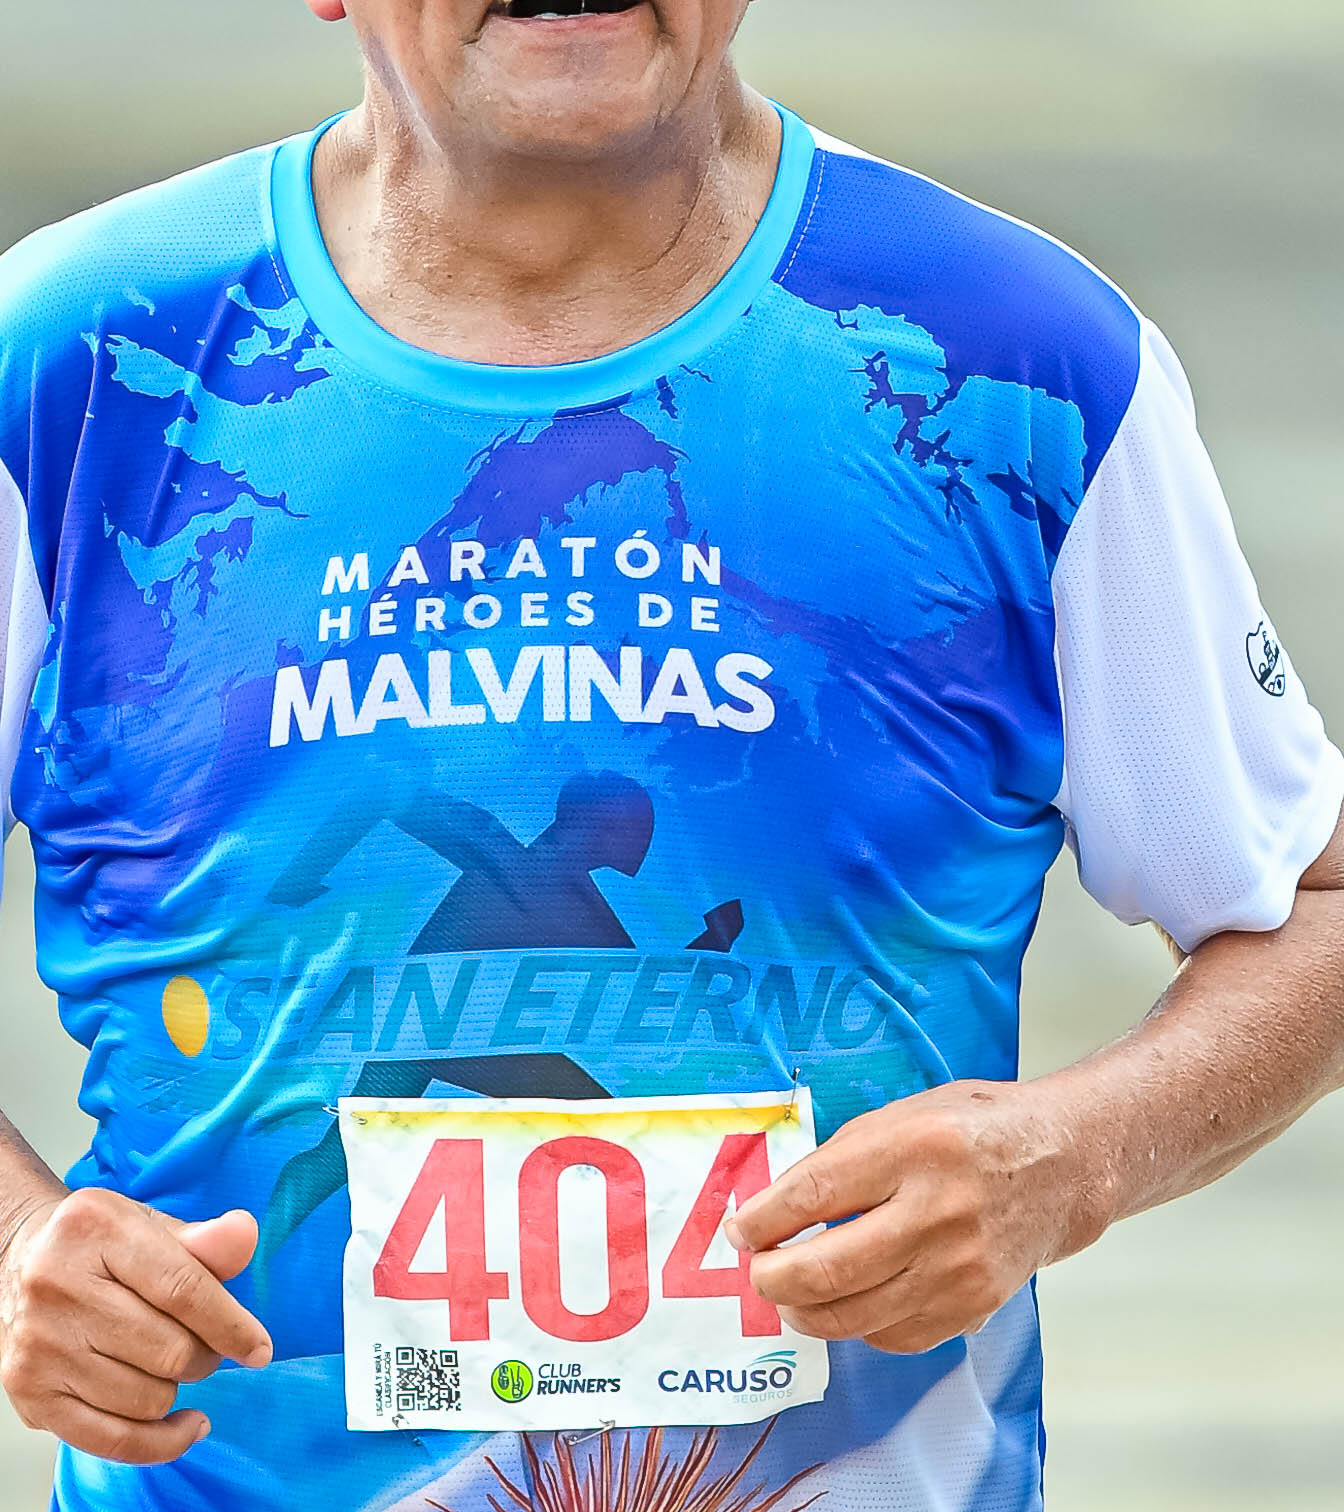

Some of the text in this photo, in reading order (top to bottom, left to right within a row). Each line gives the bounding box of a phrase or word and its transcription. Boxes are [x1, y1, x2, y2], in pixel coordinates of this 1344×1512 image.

[321, 528, 721, 596] MARATÓN
[317, 590, 721, 643] HÉROES DE
[268, 644, 776, 748] MALVINAS
[372, 1130, 783, 1343] 404
[537, 1377, 621, 1396] RUNNER'S
[538, 1362, 582, 1379] CLUB
[657, 1366, 793, 1393] CARUSO
[732, 1388, 793, 1404] SEGUROS
